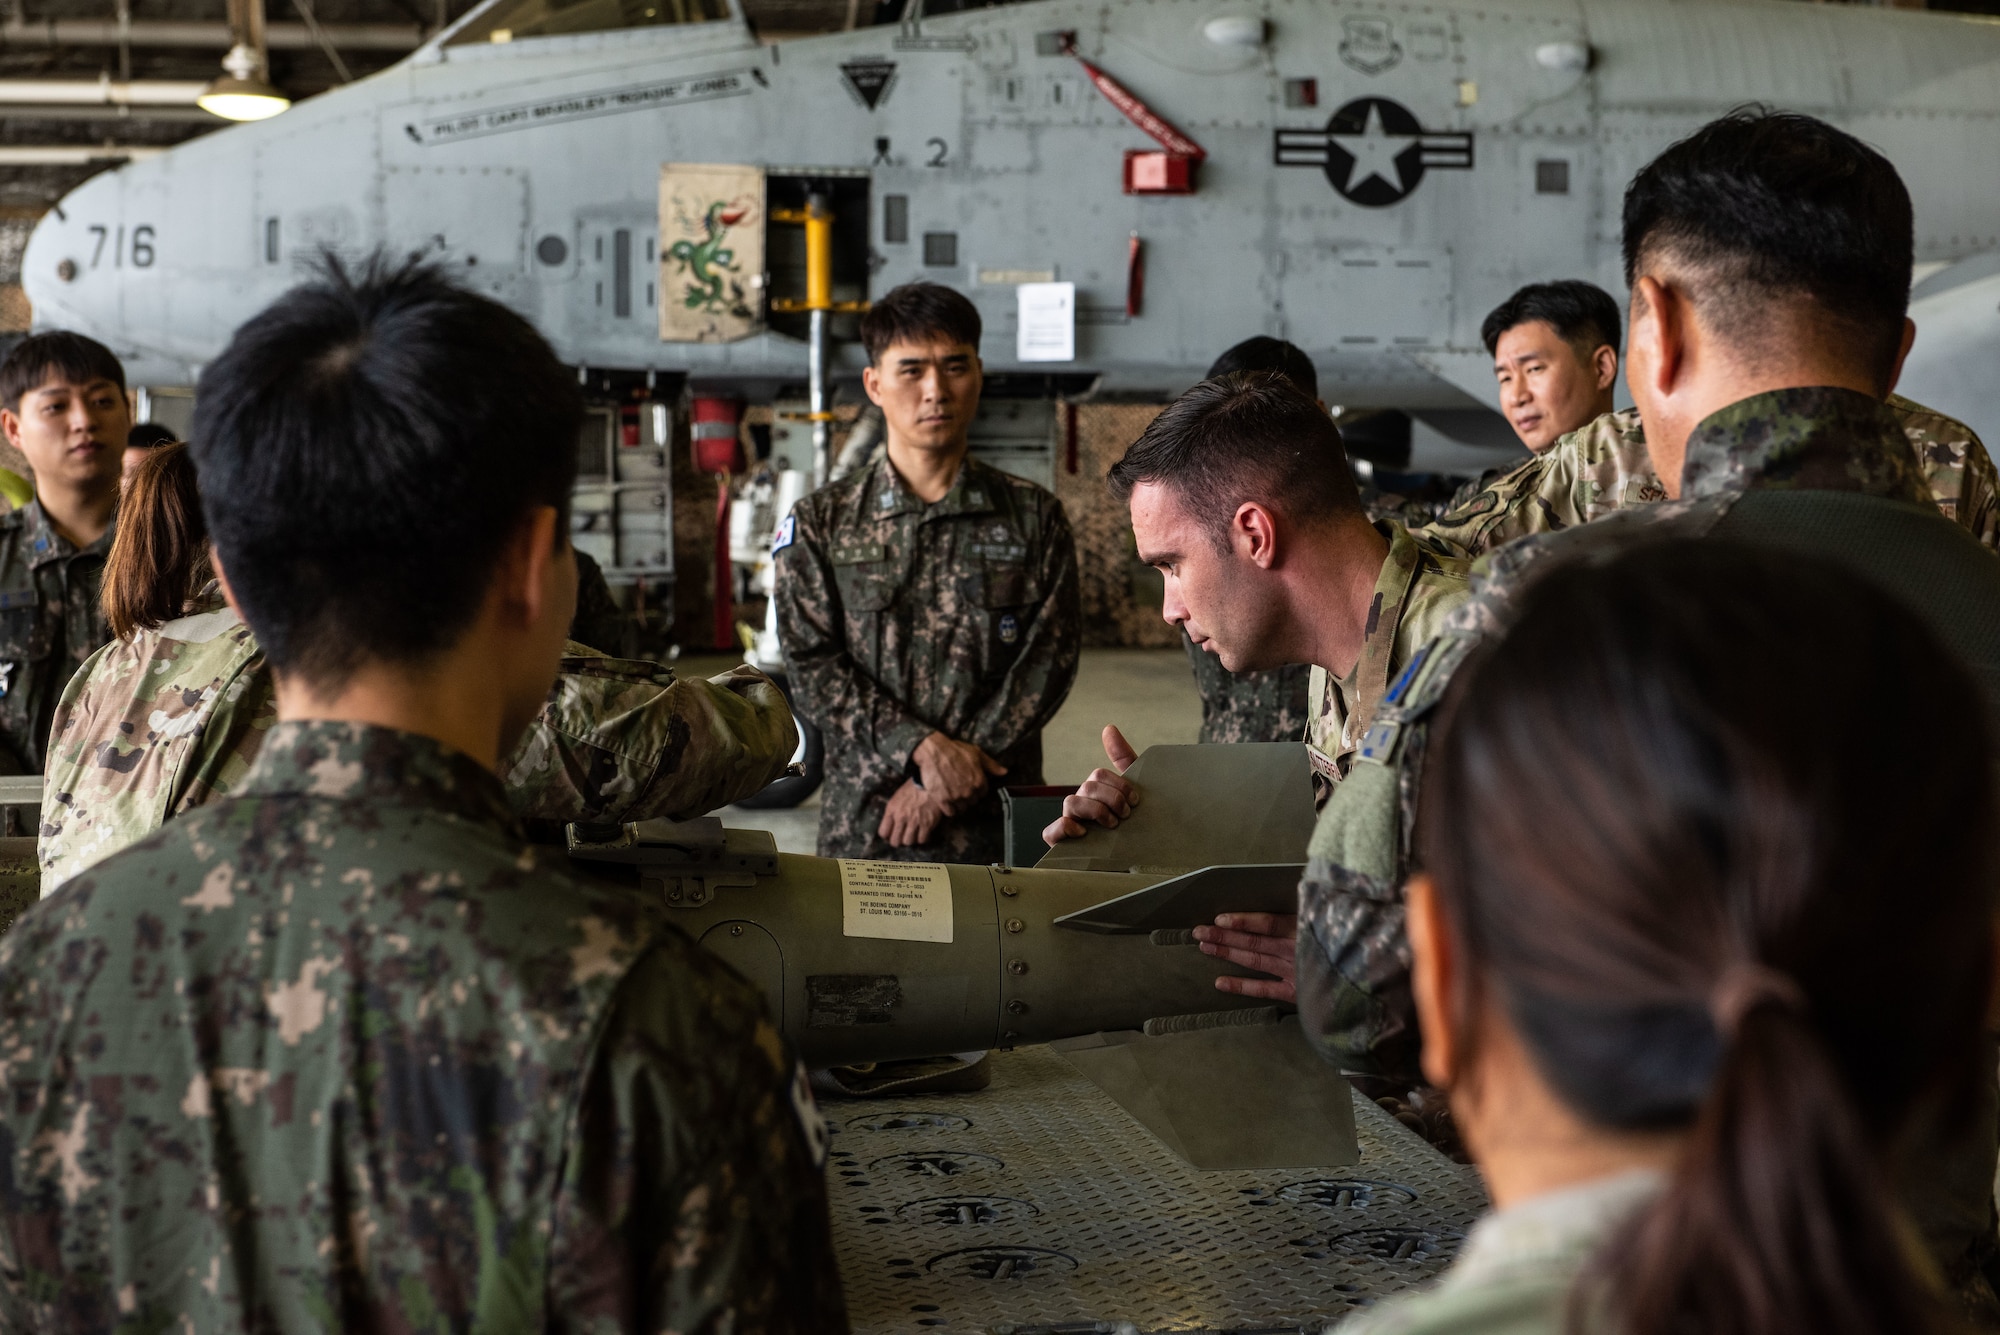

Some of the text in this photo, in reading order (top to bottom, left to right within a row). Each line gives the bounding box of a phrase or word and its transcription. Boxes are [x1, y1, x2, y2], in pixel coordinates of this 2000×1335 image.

[925, 137, 949, 168] 2
[88, 224, 157, 269] 716
[868, 908, 883, 916] LOUIS
[869, 901, 887, 909] BOEING
